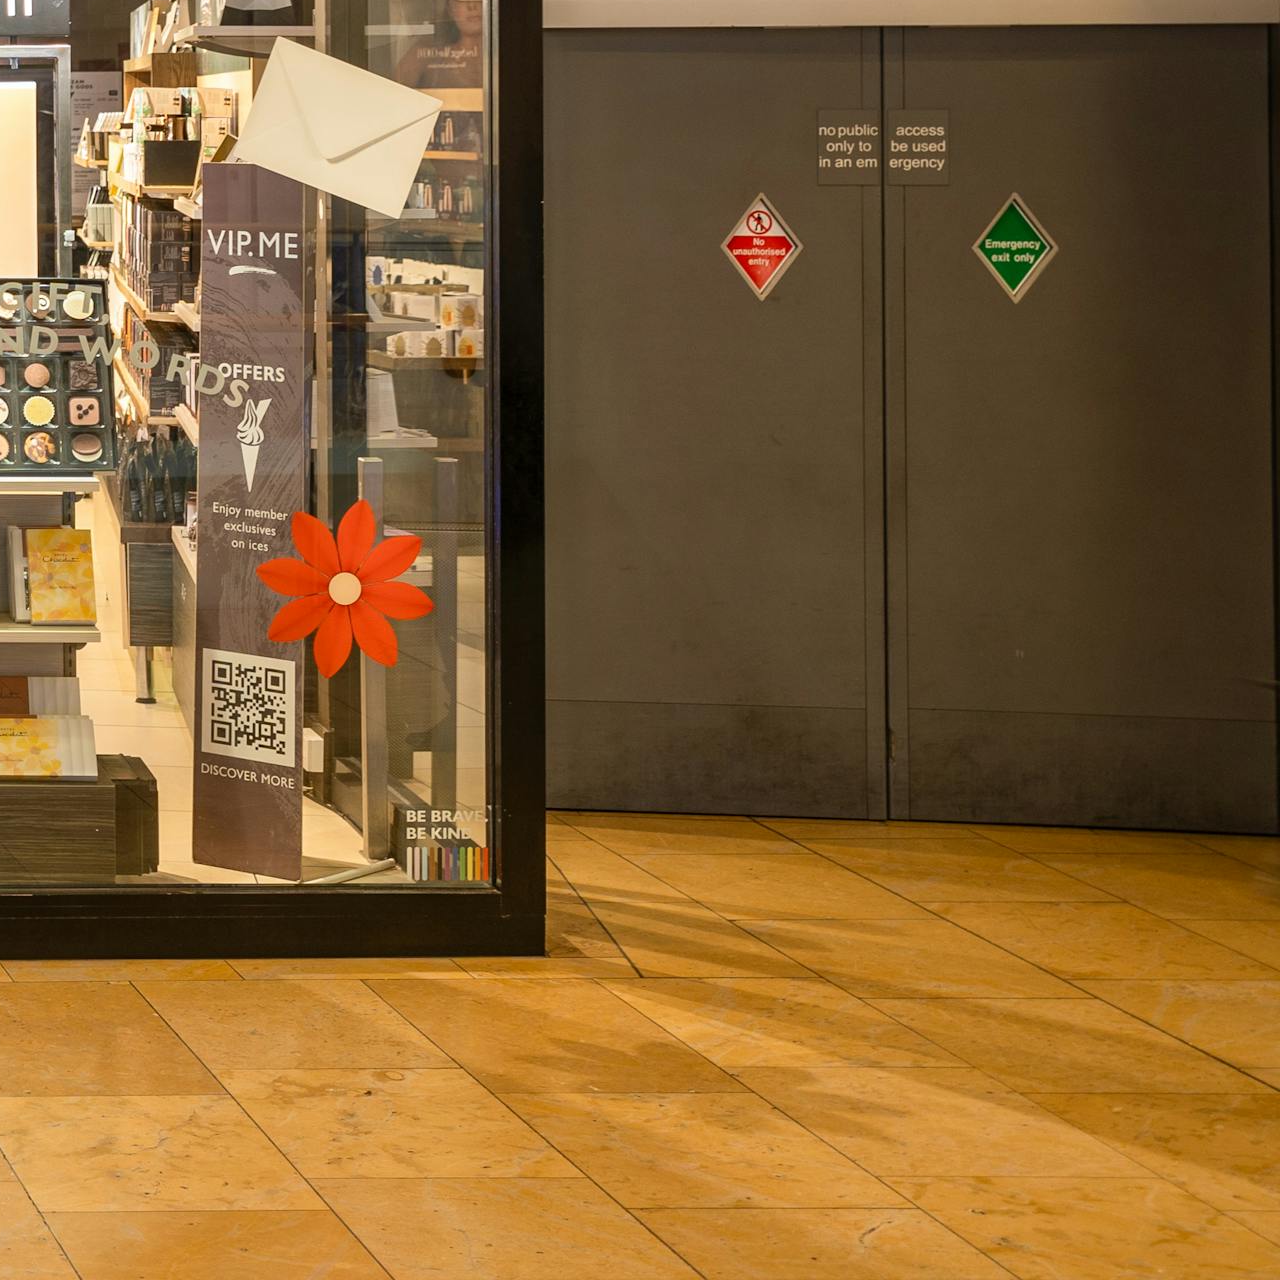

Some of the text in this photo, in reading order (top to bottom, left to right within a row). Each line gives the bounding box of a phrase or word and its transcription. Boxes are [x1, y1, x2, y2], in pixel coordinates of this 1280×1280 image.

[819, 124, 945, 139] no public access
[826, 140, 946, 155] only to be used
[819, 156, 945, 171] in an em ergency
[207, 229, 298, 259] VIP.ME
[753, 237, 765, 246] No
[985, 239, 1041, 250] Emergency
[748, 257, 770, 266] entry
[991, 252, 1035, 264] exit only
[79, 335, 249, 408] WORDS
[218, 363, 285, 382] OFFERS
[213, 502, 288, 521] Enjoy member
[224, 522, 276, 536] exclusives
[231, 539, 269, 552] on ices
[201, 763, 295, 789] DISCOVER MORE
[406, 810, 426, 823] BE
[406, 827, 426, 840] BE
